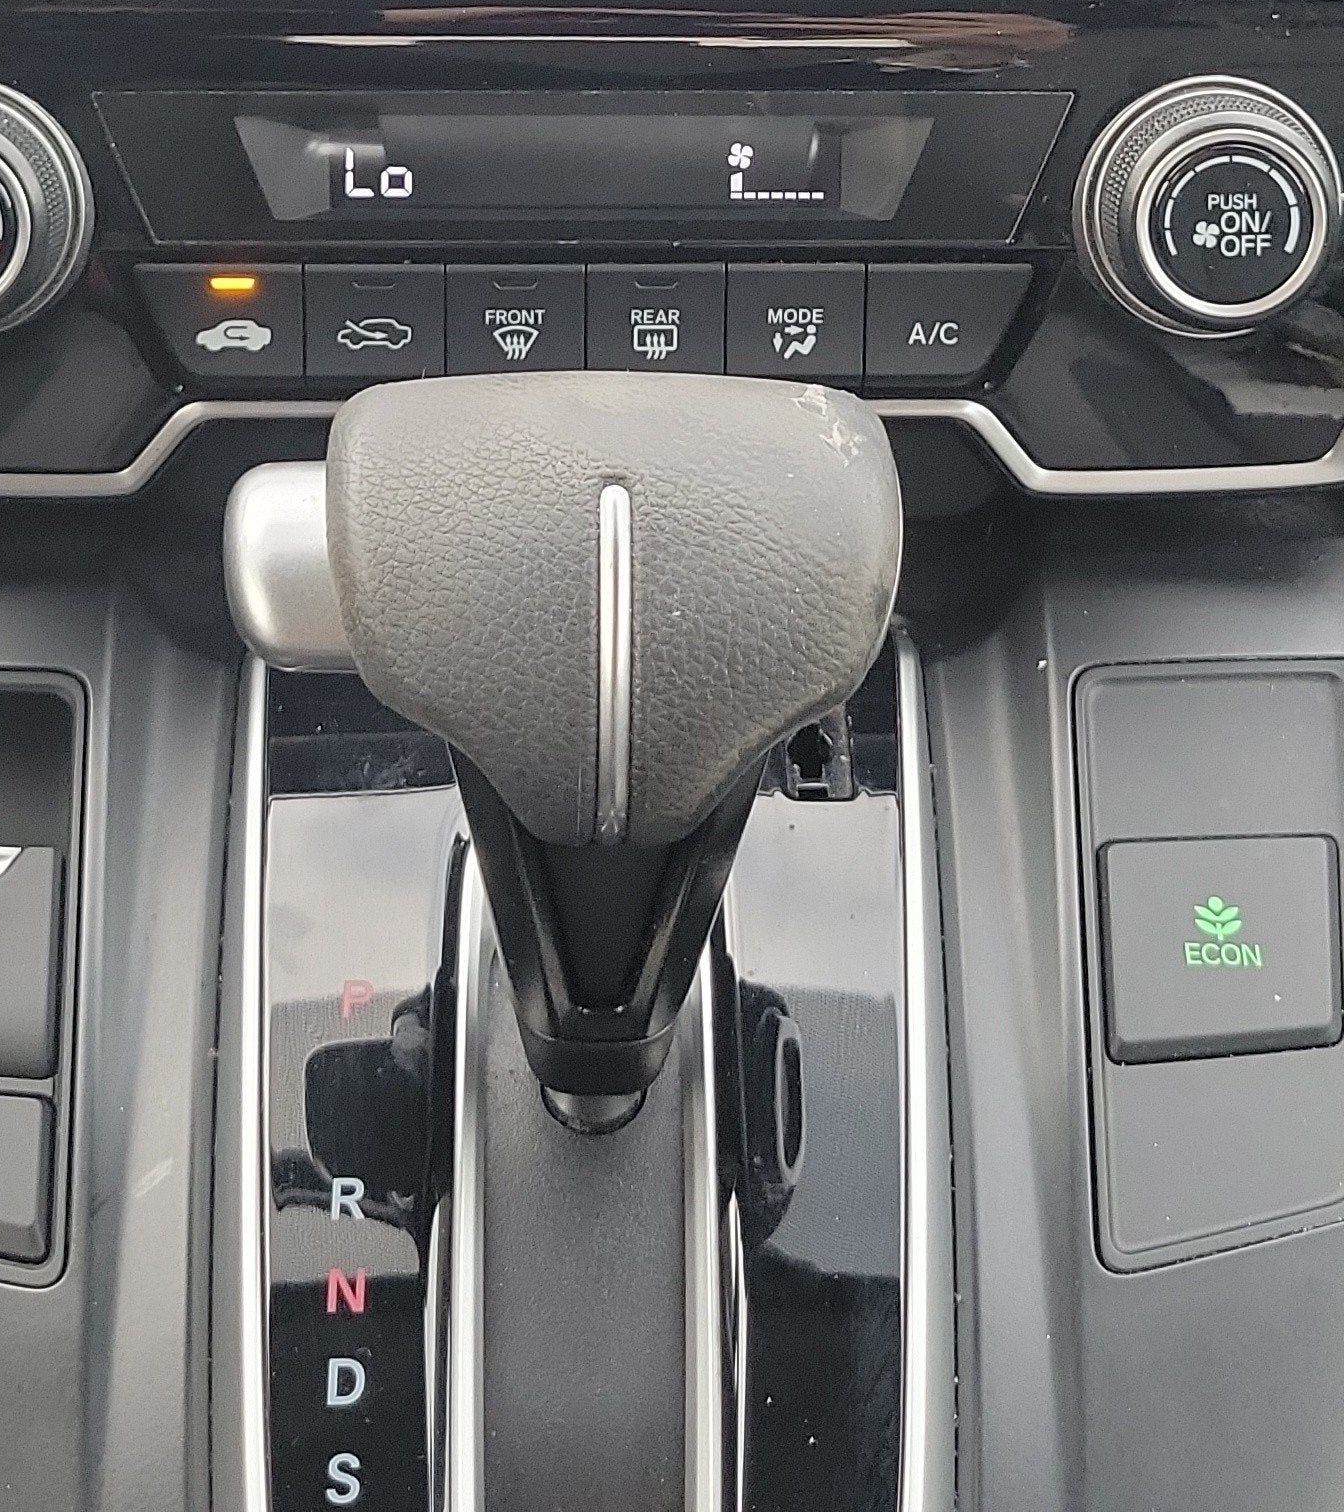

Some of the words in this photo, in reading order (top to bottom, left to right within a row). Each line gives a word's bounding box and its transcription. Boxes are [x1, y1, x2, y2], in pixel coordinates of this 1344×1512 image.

[344, 148, 413, 198] Lo
[1207, 193, 1259, 212] PUSH
[1219, 211, 1272, 234] ON/
[1220, 234, 1272, 258] OFF
[484, 308, 546, 326] FRONT
[630, 309, 681, 326] REAR
[767, 308, 825, 326] MODE
[908, 322, 959, 347] A/C
[1184, 941, 1263, 967] ECON
[342, 979, 374, 1018] P
[330, 1177, 365, 1220] R
[326, 1268, 367, 1314] N
[327, 1358, 366, 1407] D
[326, 1454, 362, 1505] S
